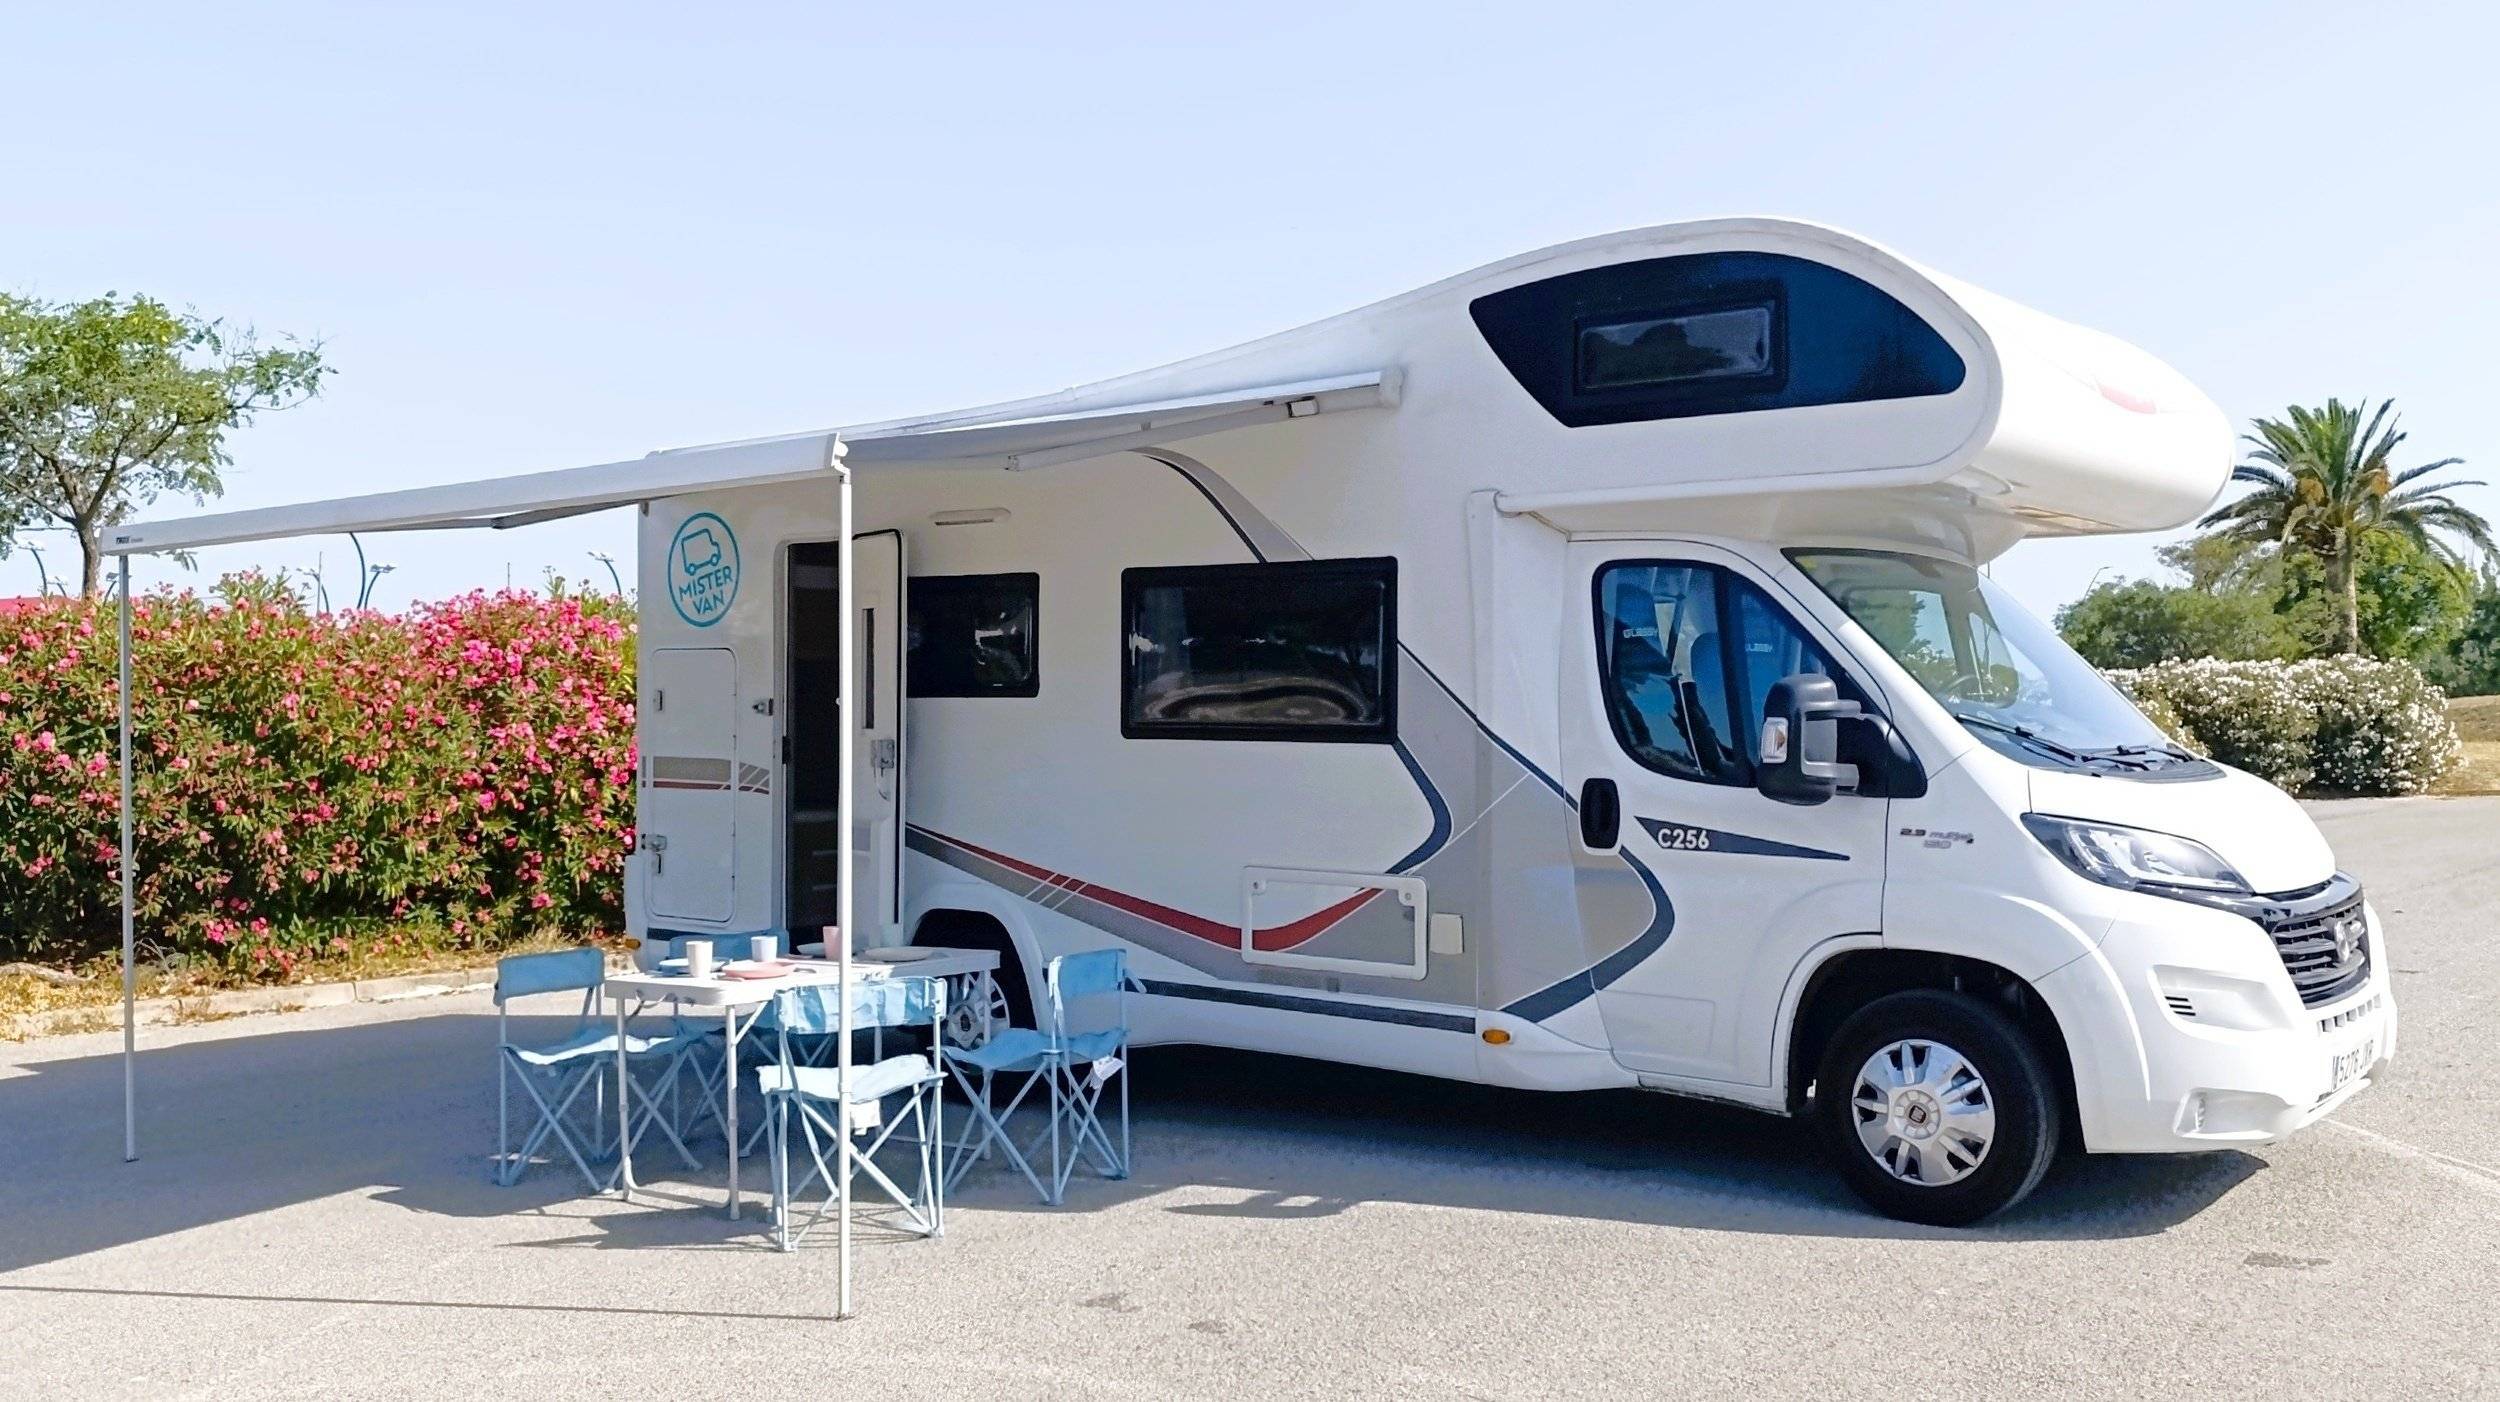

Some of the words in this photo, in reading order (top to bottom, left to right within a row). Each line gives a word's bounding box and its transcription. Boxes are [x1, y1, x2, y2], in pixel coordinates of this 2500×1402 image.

[679, 565, 733, 601] MISTER
[693, 590, 725, 614] VAN
[1657, 828, 1710, 850] C256
